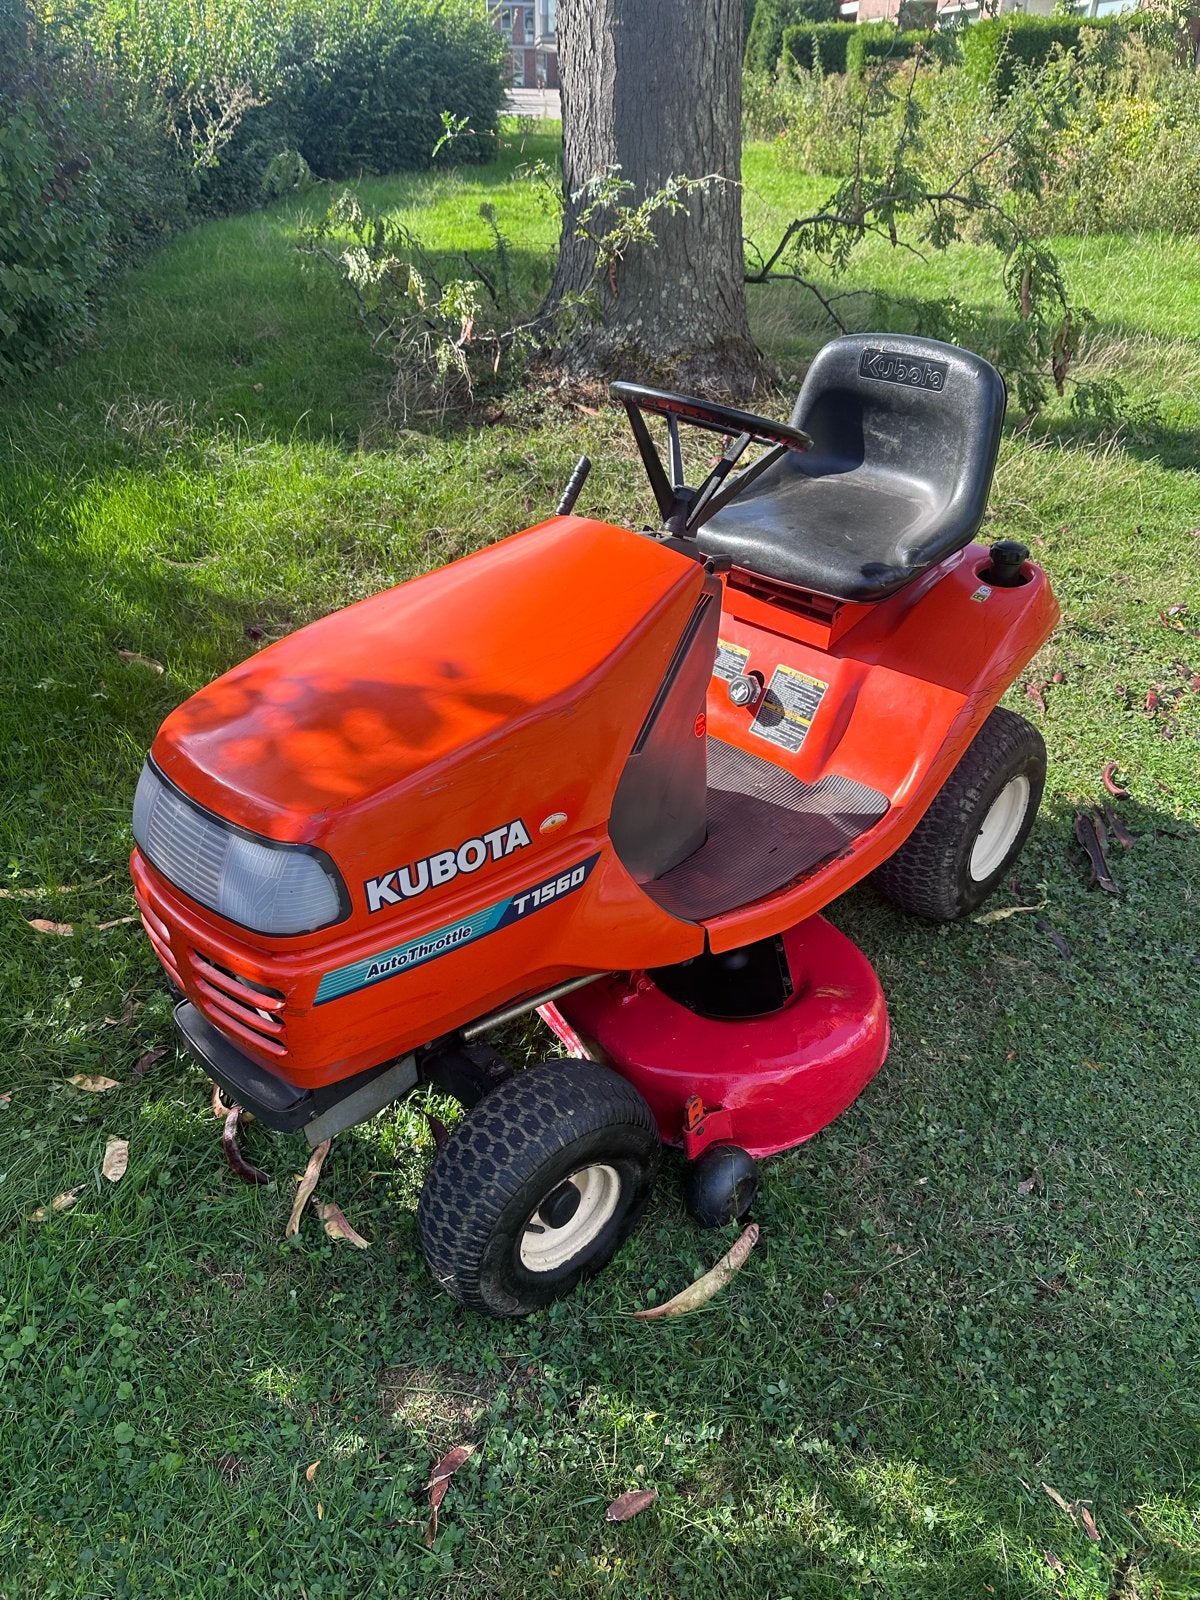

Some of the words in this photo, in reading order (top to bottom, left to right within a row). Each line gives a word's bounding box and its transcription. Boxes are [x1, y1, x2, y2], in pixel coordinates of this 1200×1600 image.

[862, 352, 944, 388] Kubota
[365, 818, 532, 913] KUBOTA
[513, 866, 586, 915] T1560
[366, 926, 473, 980] AutoThrottle
